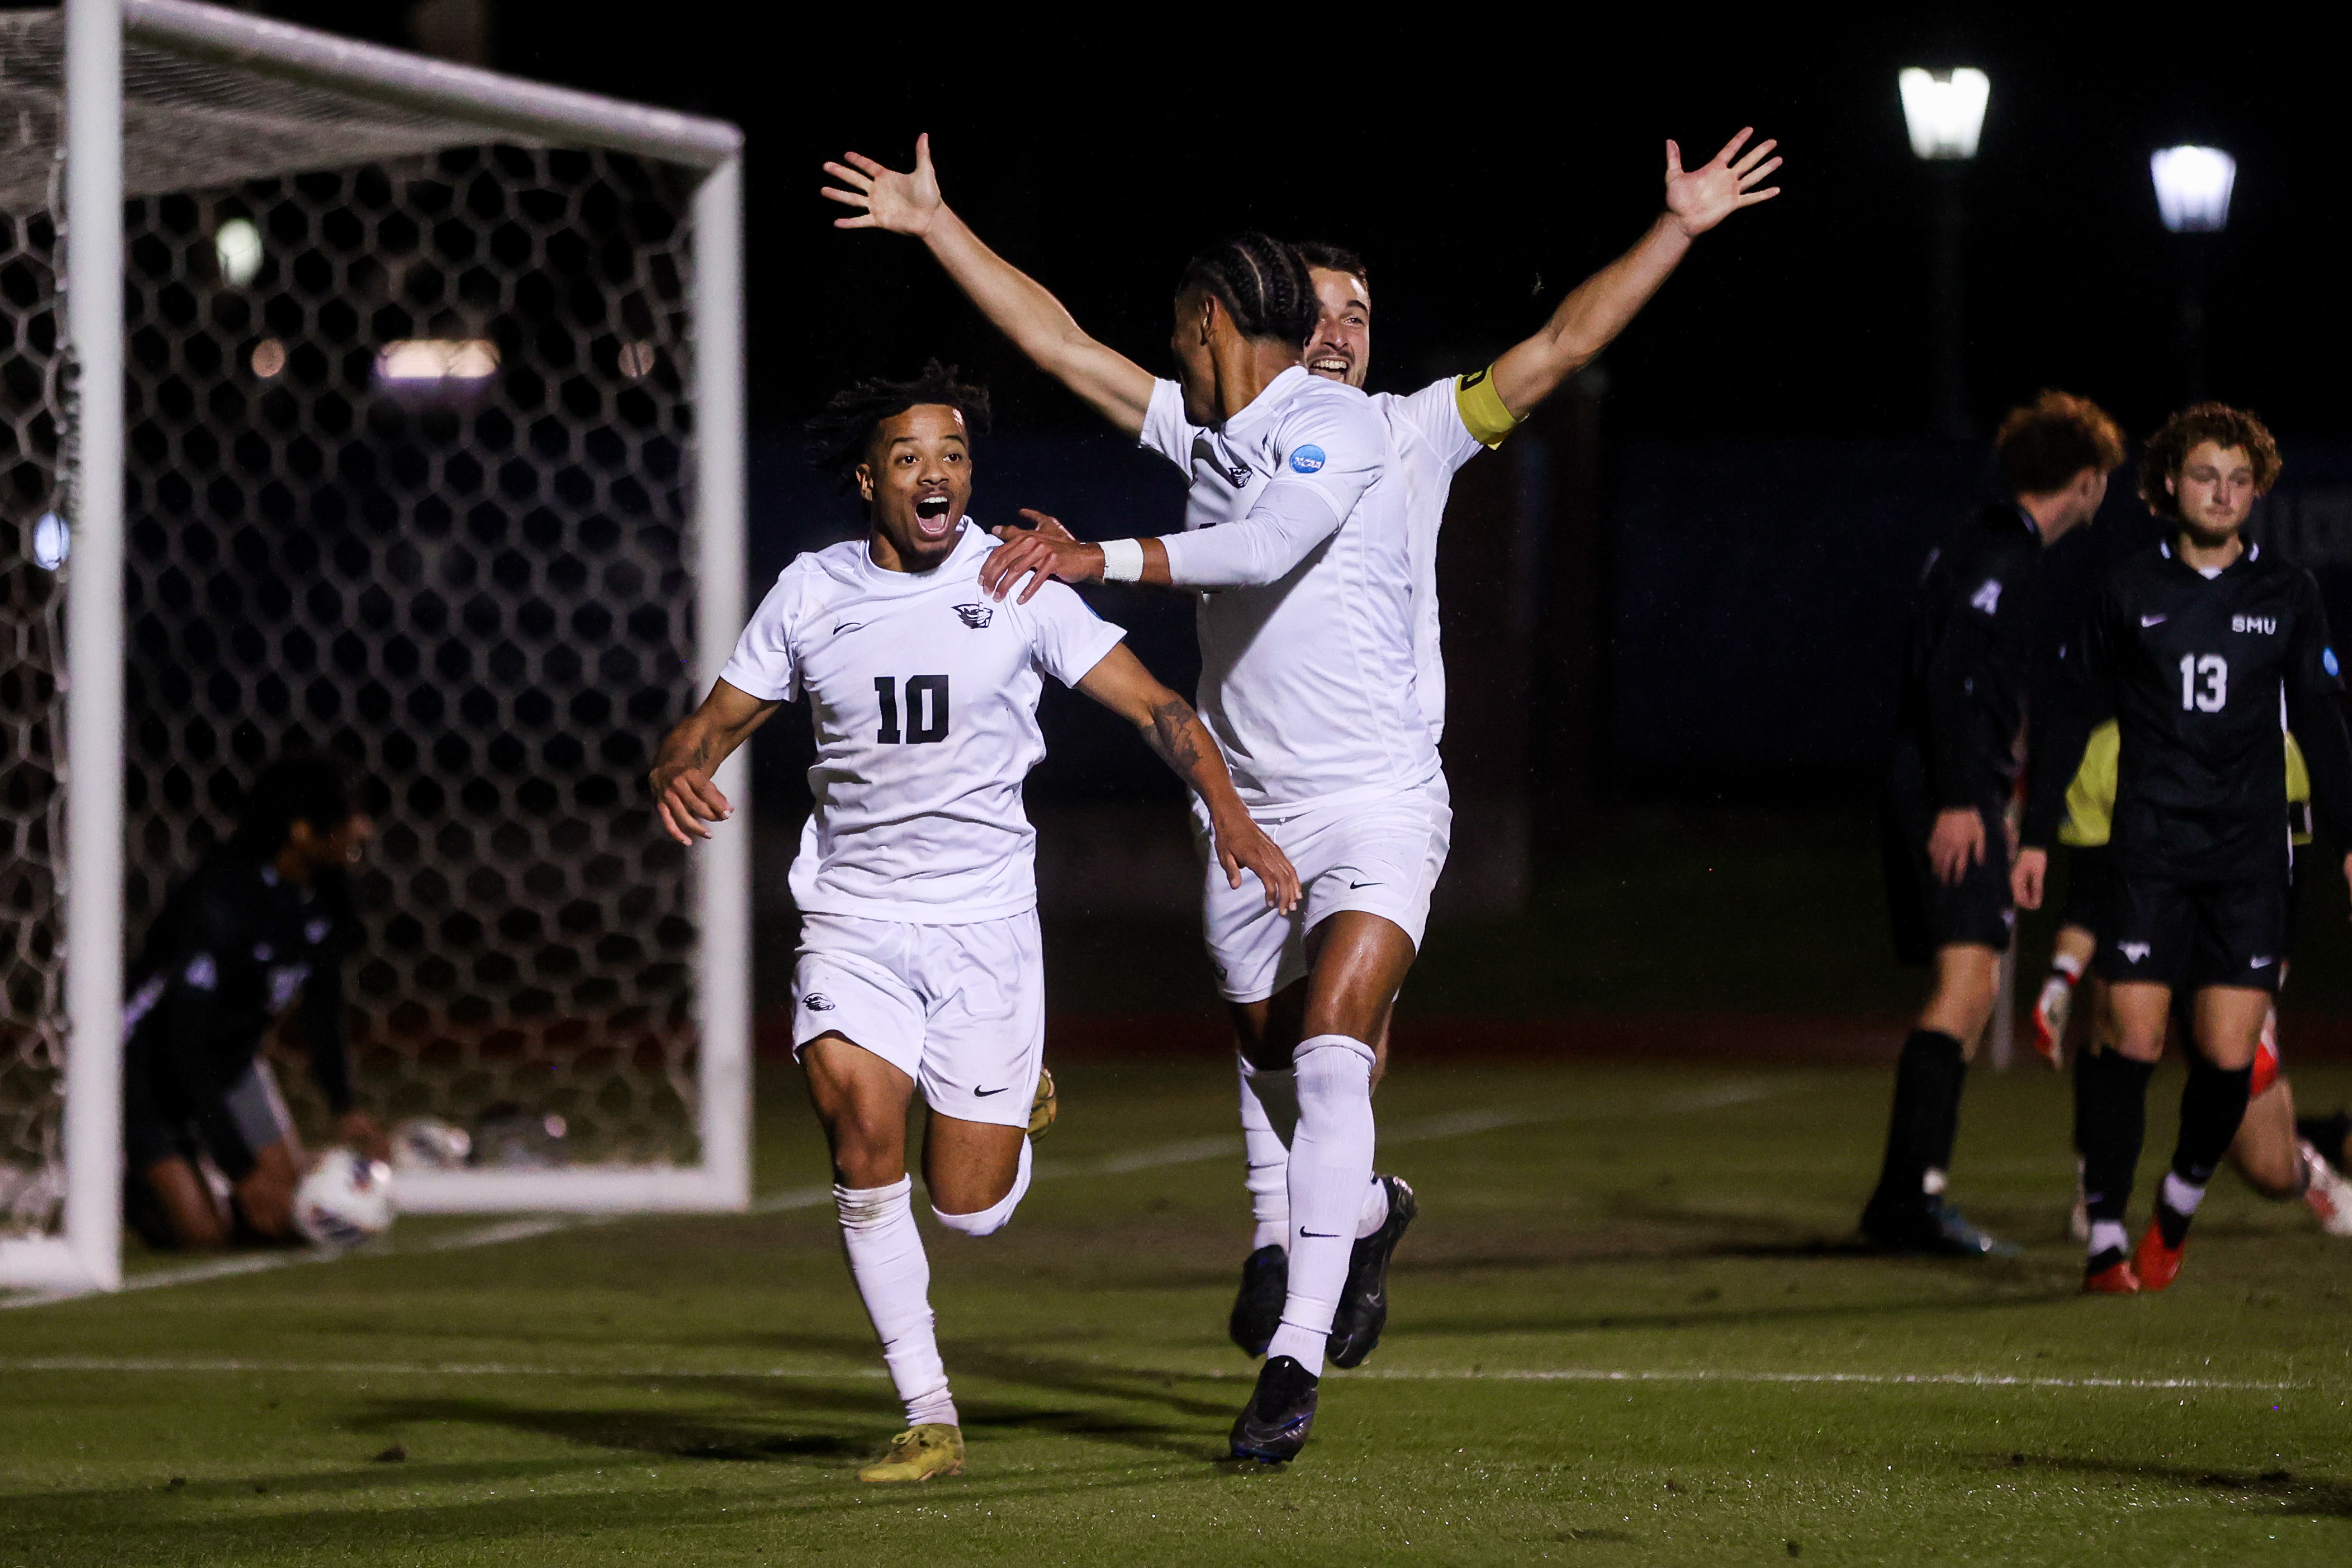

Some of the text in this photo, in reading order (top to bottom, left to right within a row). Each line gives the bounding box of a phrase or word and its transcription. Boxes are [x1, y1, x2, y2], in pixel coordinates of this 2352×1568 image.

[2232, 615, 2277, 635] SMU
[874, 675, 949, 744] 10
[2180, 653, 2227, 713] 13
